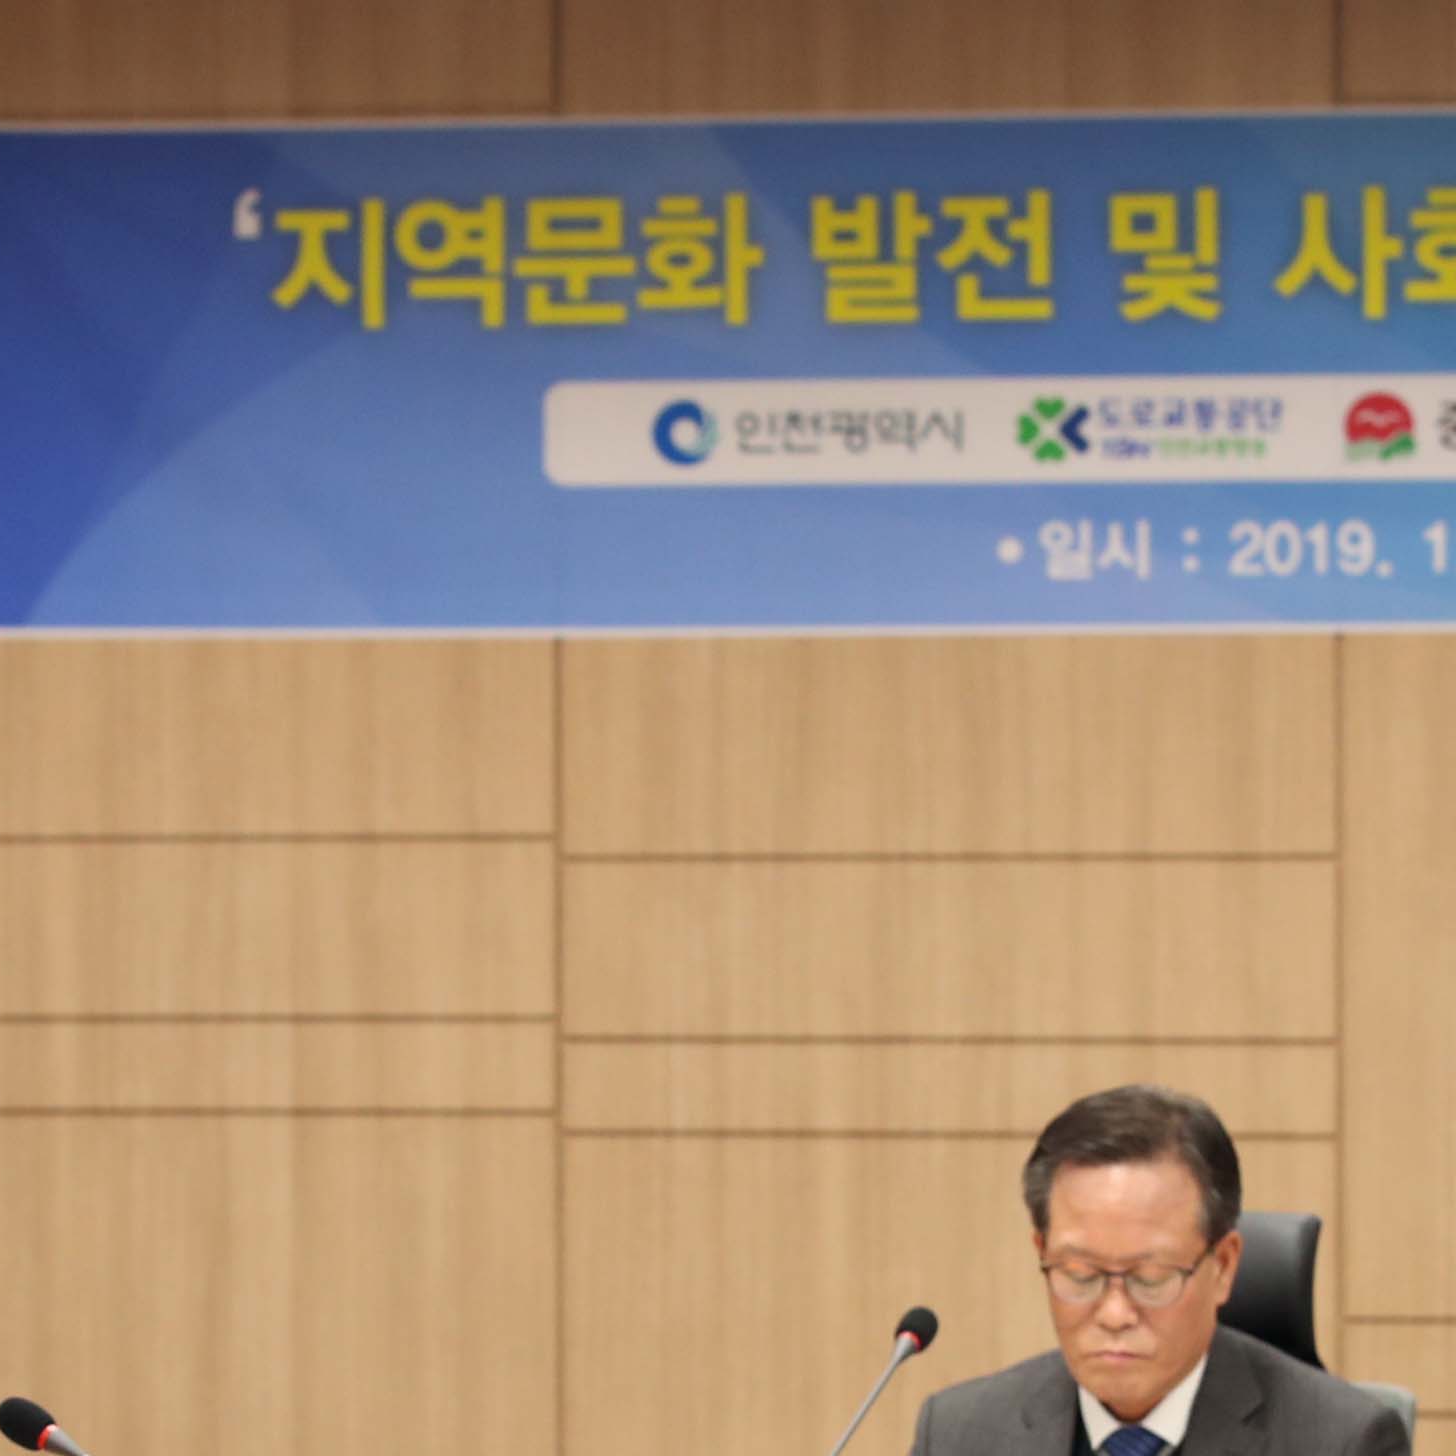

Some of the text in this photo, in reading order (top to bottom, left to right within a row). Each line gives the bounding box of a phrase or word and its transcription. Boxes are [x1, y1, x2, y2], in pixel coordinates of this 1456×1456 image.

[811, 189, 1055, 325] 발전
[1109, 187, 1223, 322] 및
[1038, 519, 1153, 583] 일시
[1227, 519, 1394, 577] 2019.
